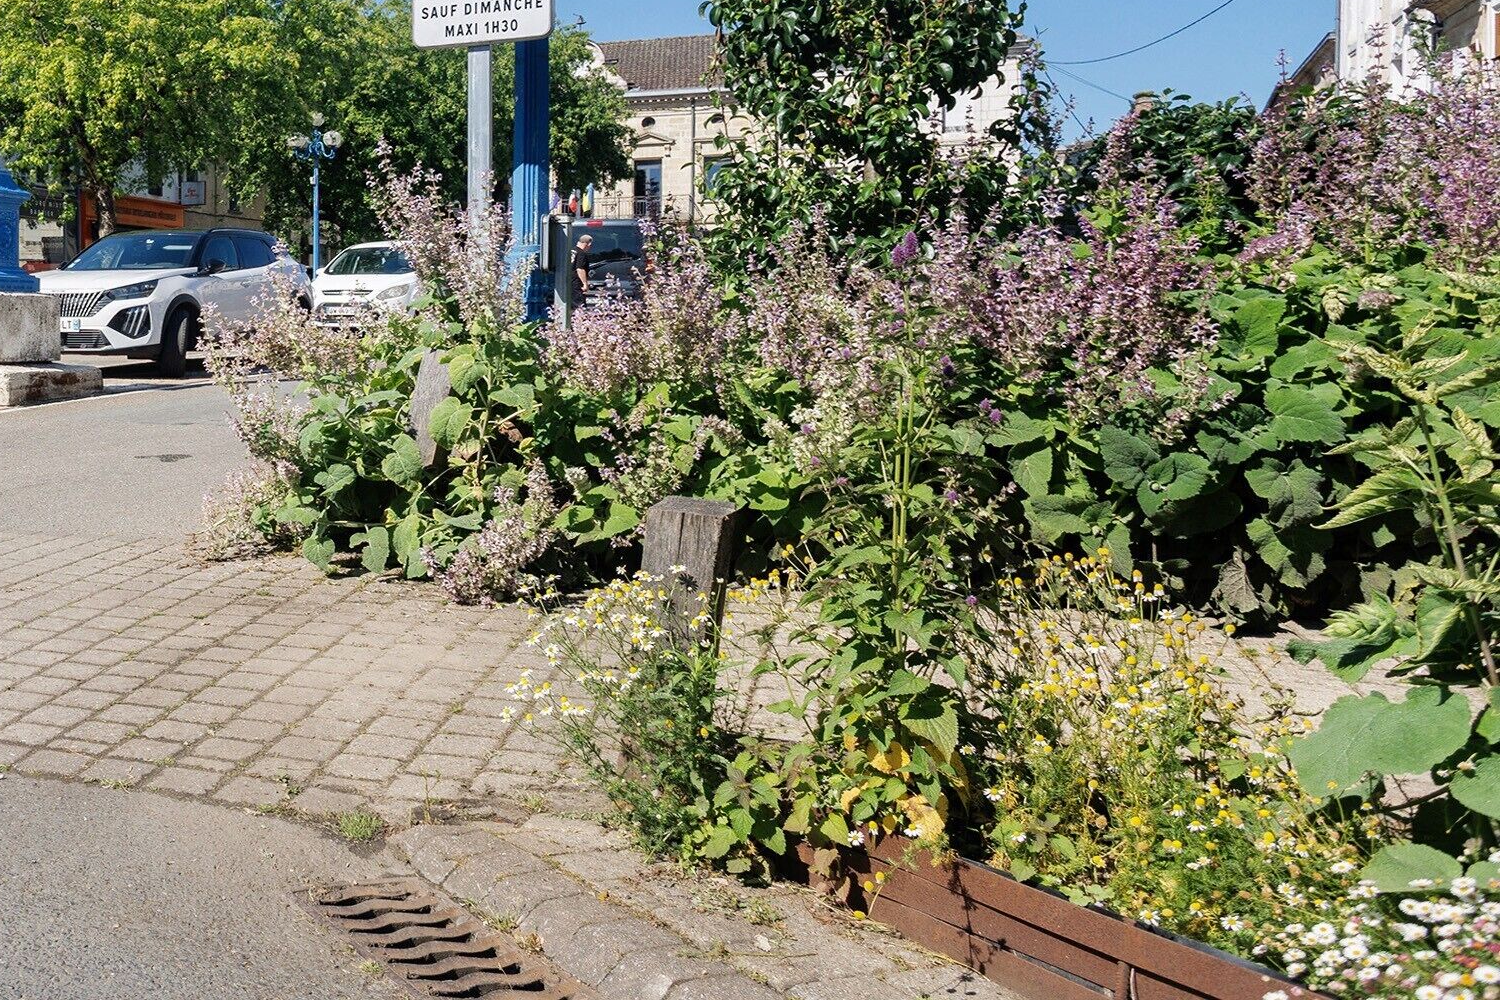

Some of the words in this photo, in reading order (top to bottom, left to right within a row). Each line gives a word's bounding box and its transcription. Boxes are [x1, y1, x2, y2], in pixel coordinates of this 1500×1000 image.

[421, 4, 458, 20] SAUF
[445, 22, 478, 38] MAXI
[484, 19, 519, 34] 1H30
